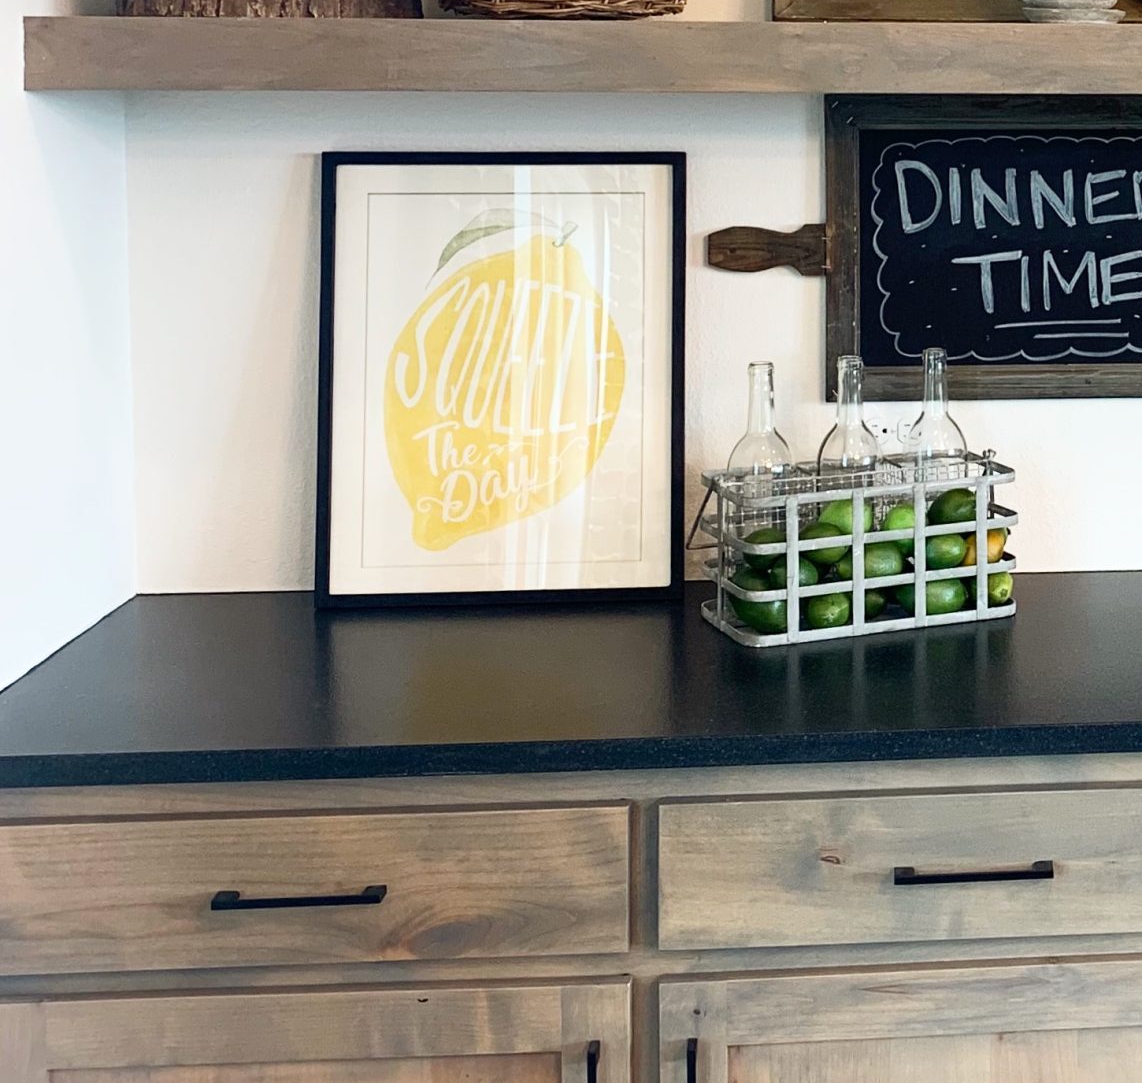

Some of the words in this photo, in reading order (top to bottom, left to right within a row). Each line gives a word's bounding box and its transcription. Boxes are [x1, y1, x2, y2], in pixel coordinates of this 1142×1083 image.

[394, 275, 615, 437] SQUEEZE
[411, 420, 481, 477] The
[416, 454, 562, 524] Day
